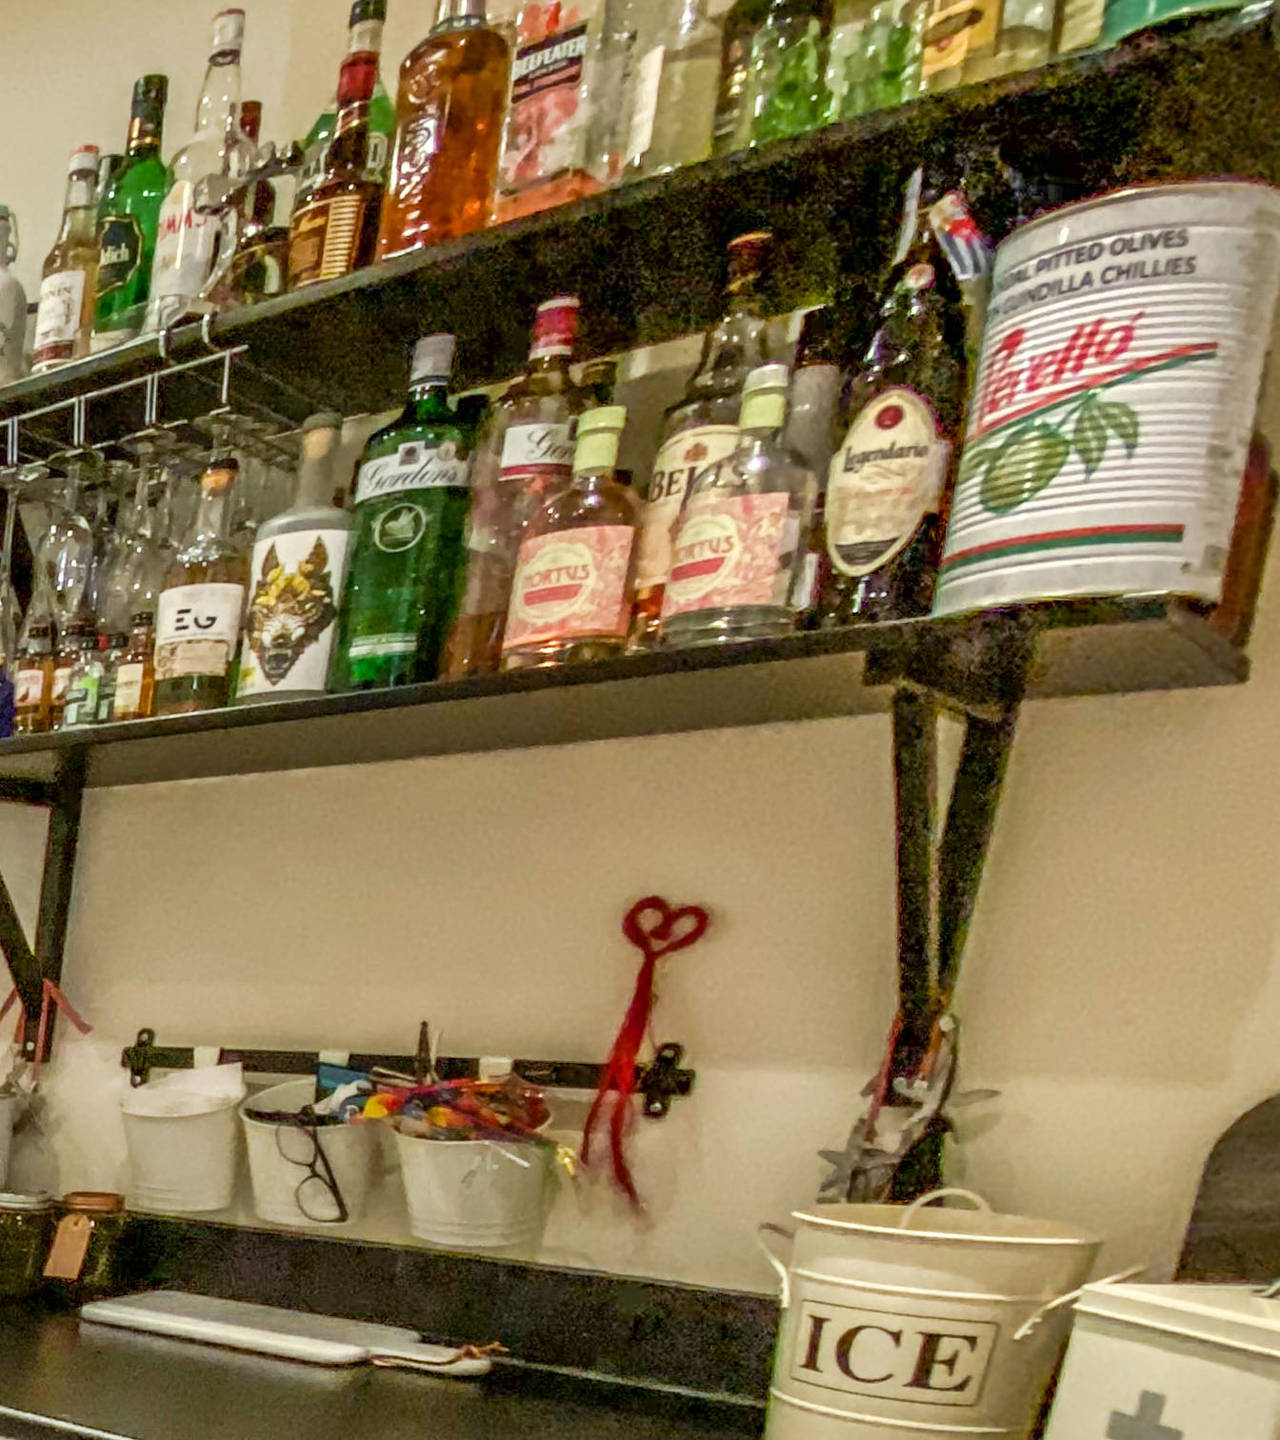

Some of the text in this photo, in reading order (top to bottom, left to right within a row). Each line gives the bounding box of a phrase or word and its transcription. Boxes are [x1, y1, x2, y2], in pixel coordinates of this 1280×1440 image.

[1036, 243, 1103, 273] PITTED
[1109, 228, 1190, 256] OLIVES
[1099, 256, 1197, 286] CHILLIES
[800, 1314, 978, 1393] ICE
